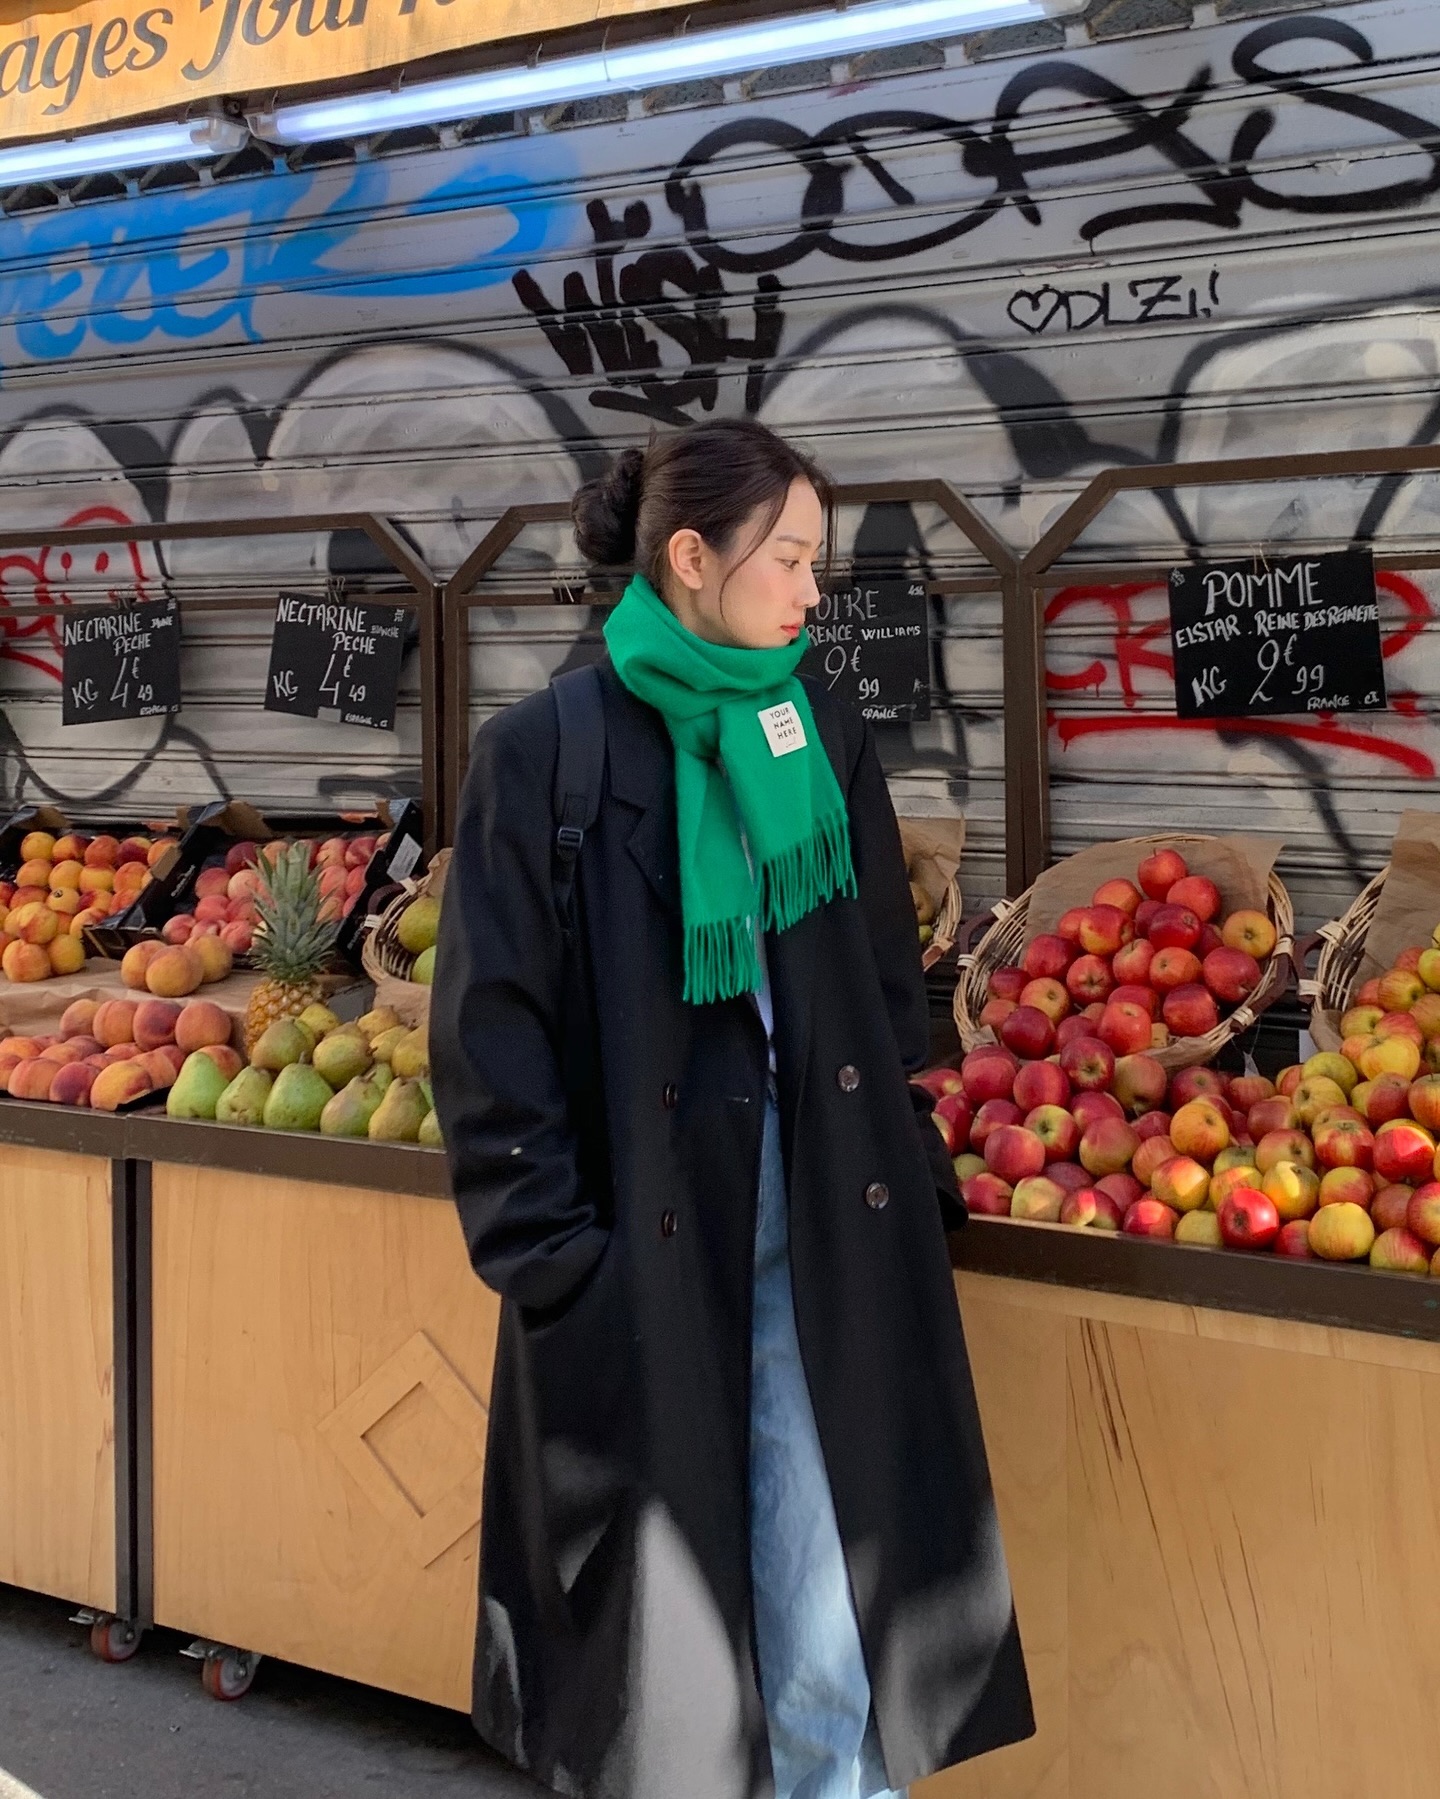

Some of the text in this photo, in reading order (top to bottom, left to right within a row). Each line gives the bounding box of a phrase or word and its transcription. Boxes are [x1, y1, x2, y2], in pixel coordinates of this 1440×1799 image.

[1202, 563, 1323, 616] POMME
[276, 598, 367, 632] NECTARINE
[1254, 609, 1300, 637] REINE
[65, 612, 143, 646] NECTARINE
[861, 626, 921, 640] WILLIAMS
[113, 633, 152, 656] PECHE
[332, 632, 376, 655] PECHE
[72, 678, 98, 710] KG
[137, 684, 153, 701] 49
[273, 670, 298, 701] KG
[349, 685, 366, 702] 49
[859, 678, 880, 700] 99
[1191, 666, 1227, 707] KG
[1292, 664, 1325, 694] 99
[770, 707, 789, 719] YOUR
[1307, 694, 1350, 710] FRANCE
[773, 717, 793, 729] NAME
[777, 727, 797, 739] HERE
